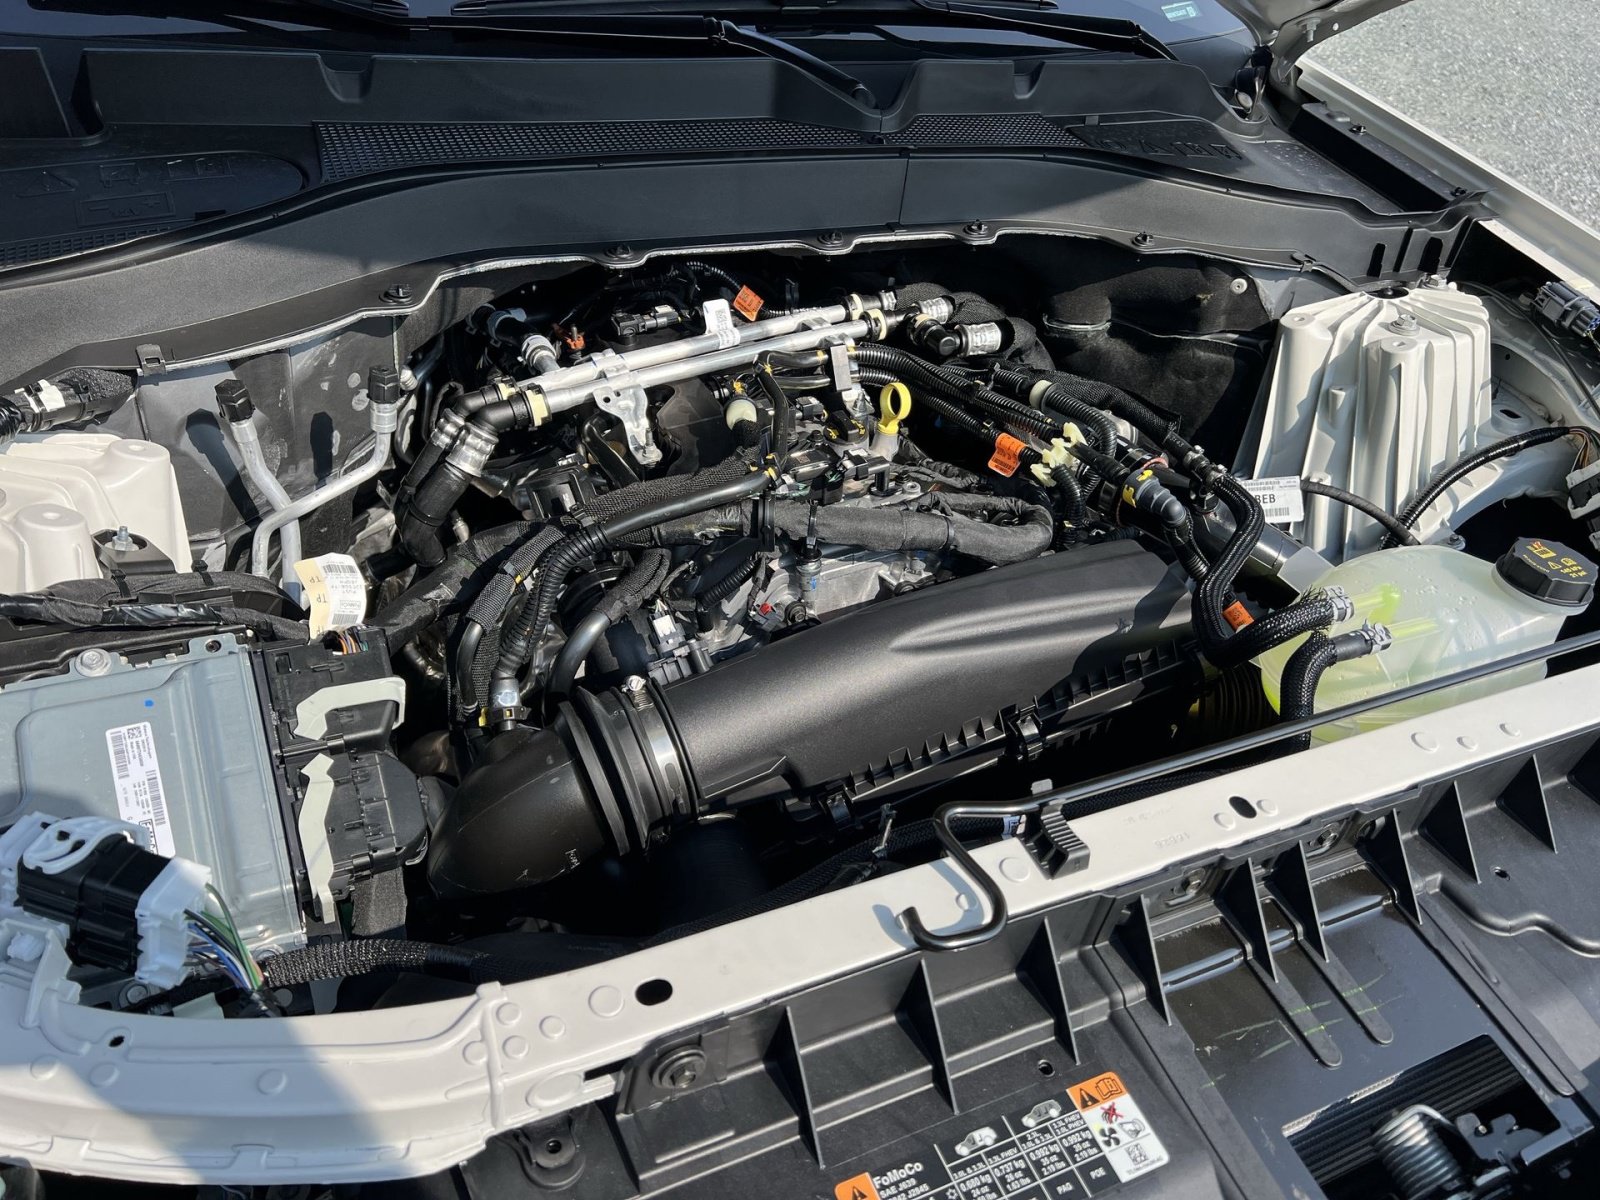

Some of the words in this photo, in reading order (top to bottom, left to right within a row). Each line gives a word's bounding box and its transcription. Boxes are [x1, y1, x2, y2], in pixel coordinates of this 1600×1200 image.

[1062, 1133, 1082, 1147] 0.992
[1082, 1130, 1092, 1140] kg
[1029, 1146, 1049, 1160] 0.992
[1049, 1143, 1060, 1153] kg
[994, 1163, 1013, 1177] 0.737
[1013, 1159, 1026, 1169] kg
[1090, 1167, 1106, 1179] POE
[872, 1162, 924, 1189] FoMoCo
[980, 1174, 992, 1184] kg
[1014, 1171, 1024, 1179] oz
[880, 1185, 897, 1198] SAE
[981, 1185, 990, 1194] oz
